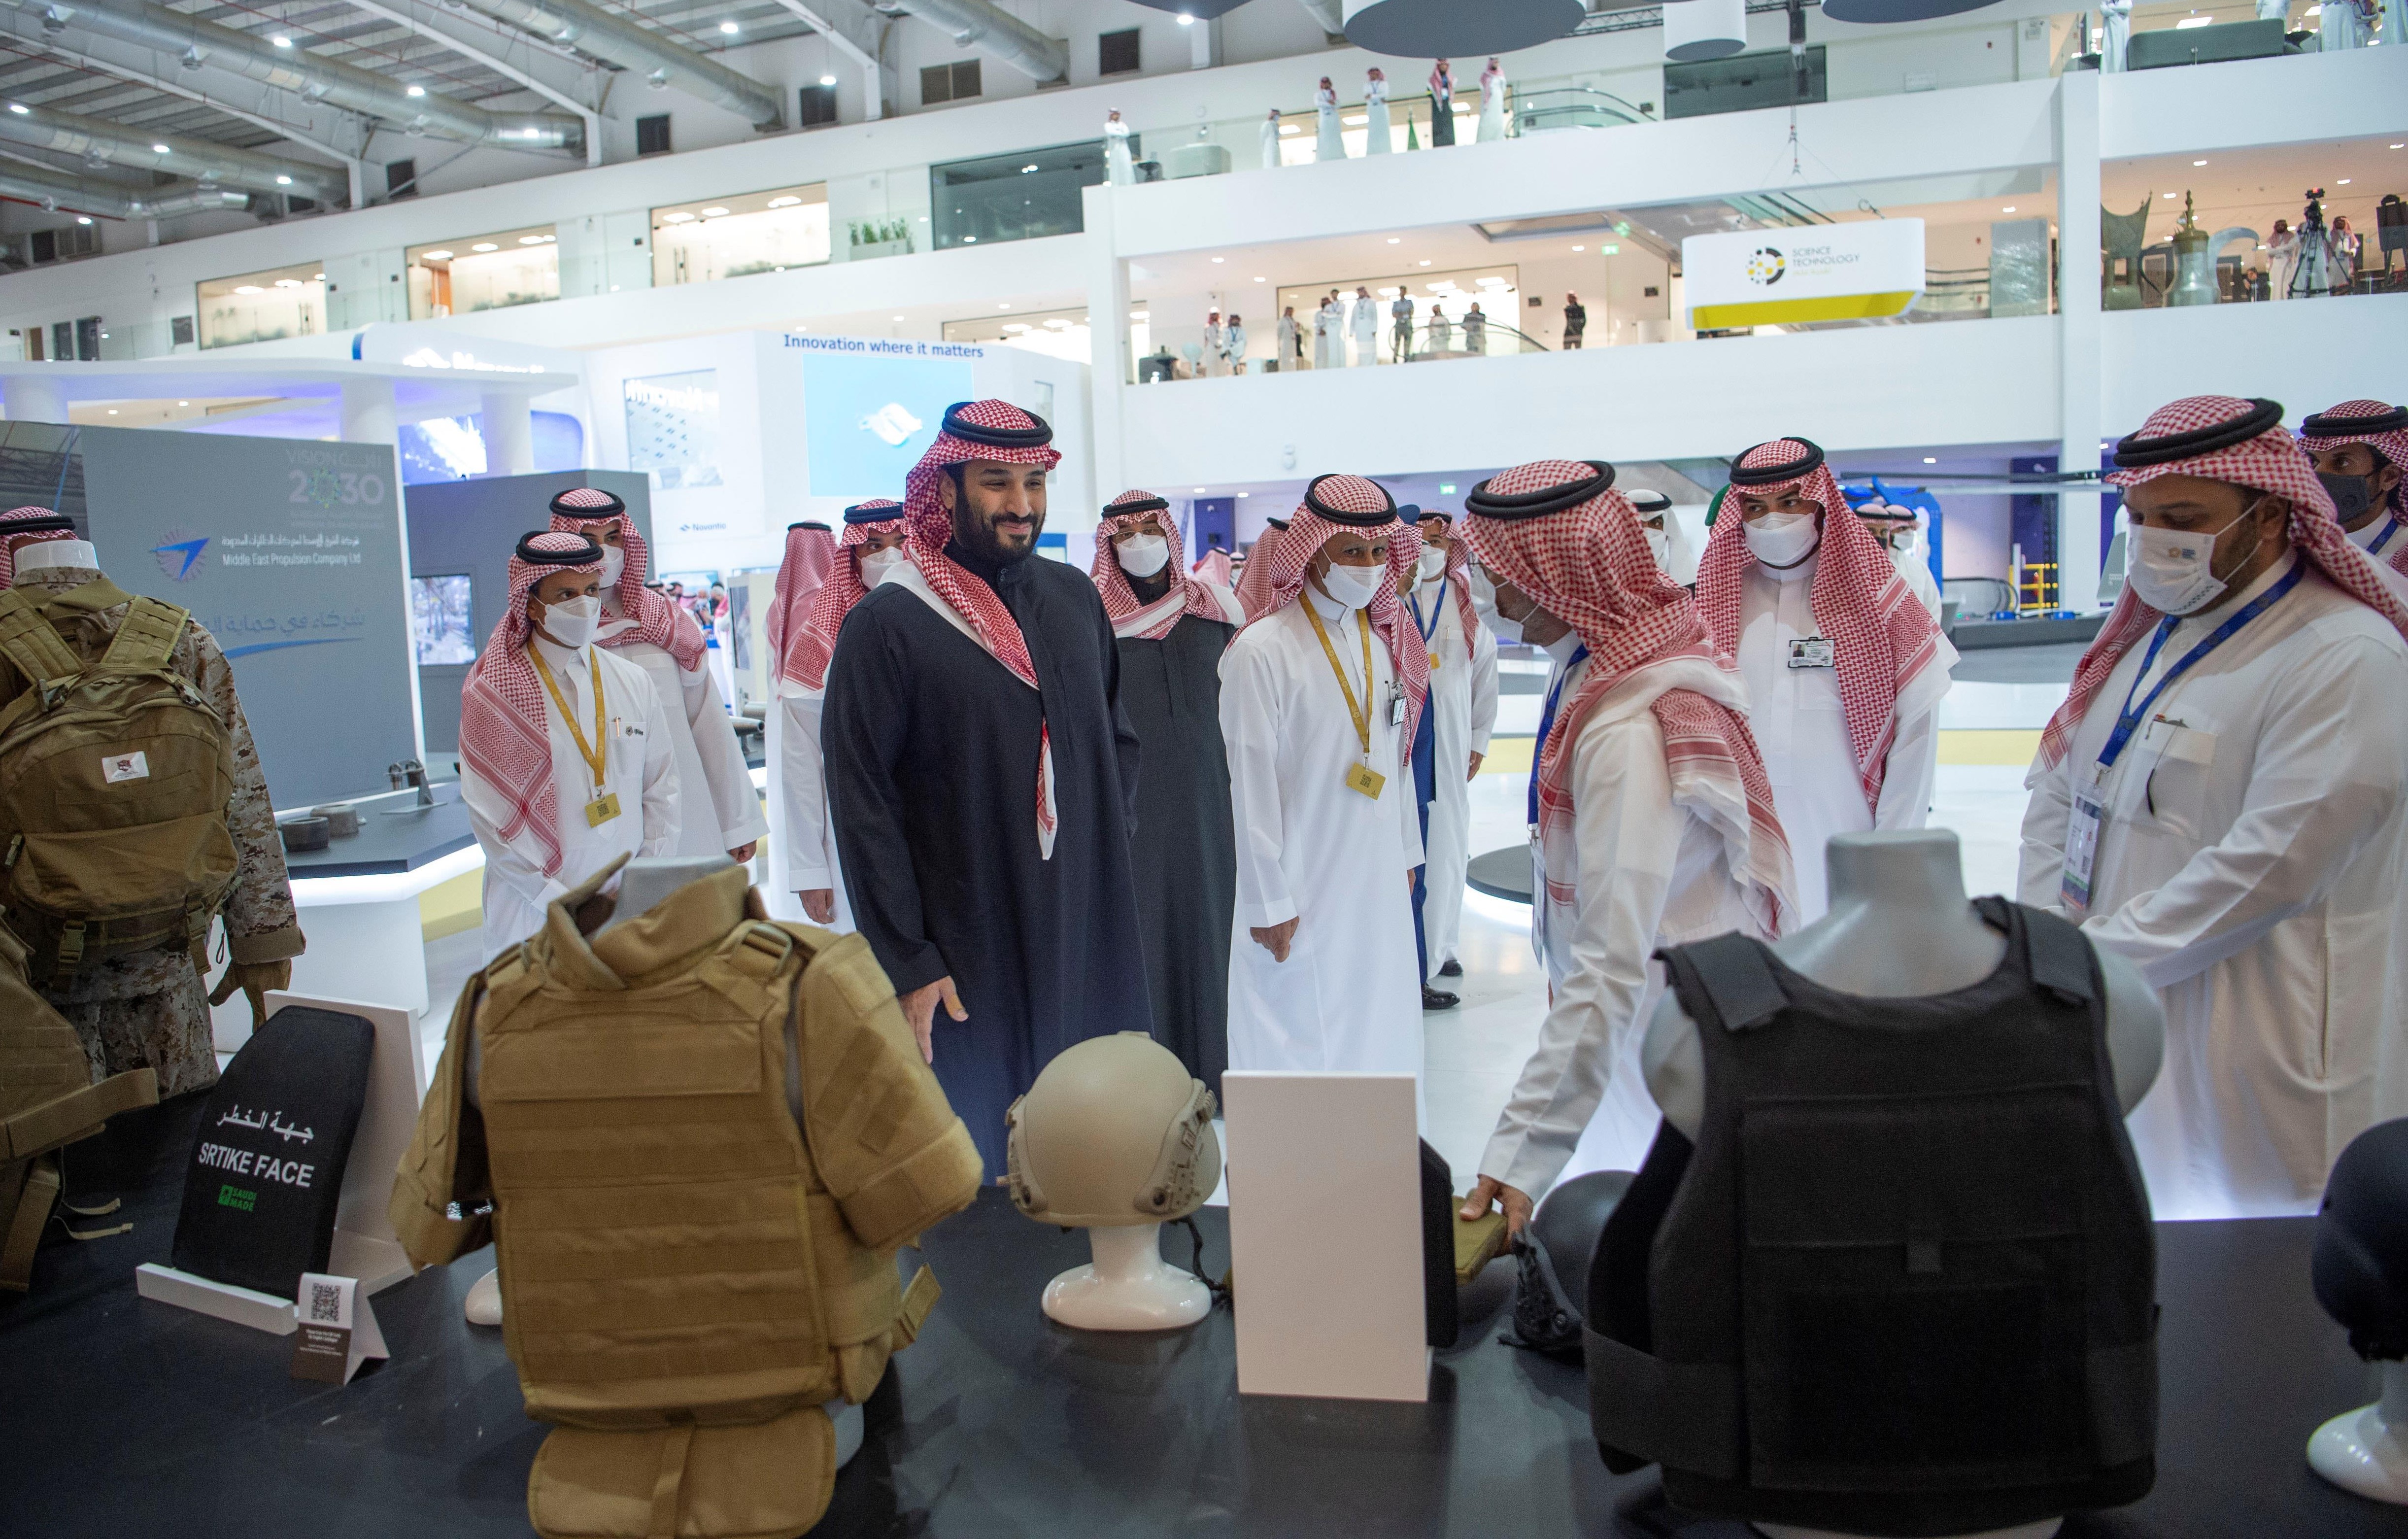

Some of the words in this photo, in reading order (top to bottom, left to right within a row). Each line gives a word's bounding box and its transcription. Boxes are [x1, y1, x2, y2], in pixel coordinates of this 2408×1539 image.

[1792, 245, 1831, 257] SCIENCE
[1792, 253, 1860, 267] TECHNOLOGY
[783, 334, 866, 352] Innovation
[869, 340, 914, 354] where
[916, 341, 928, 355] it
[931, 343, 984, 358] matters
[288, 469, 385, 506] 2030
[222, 553, 251, 566] Middle
[252, 552, 270, 565] East
[271, 552, 312, 567] Propulsion
[312, 552, 348, 567] Company
[216, 1103, 269, 1130] الخطر
[269, 1110, 315, 1145] جهة
[198, 1142, 255, 1174] SRTIKE
[253, 1154, 315, 1188] FACE
[232, 1188, 257, 1201] SAUDI
[229, 1198, 255, 1212] MADE
